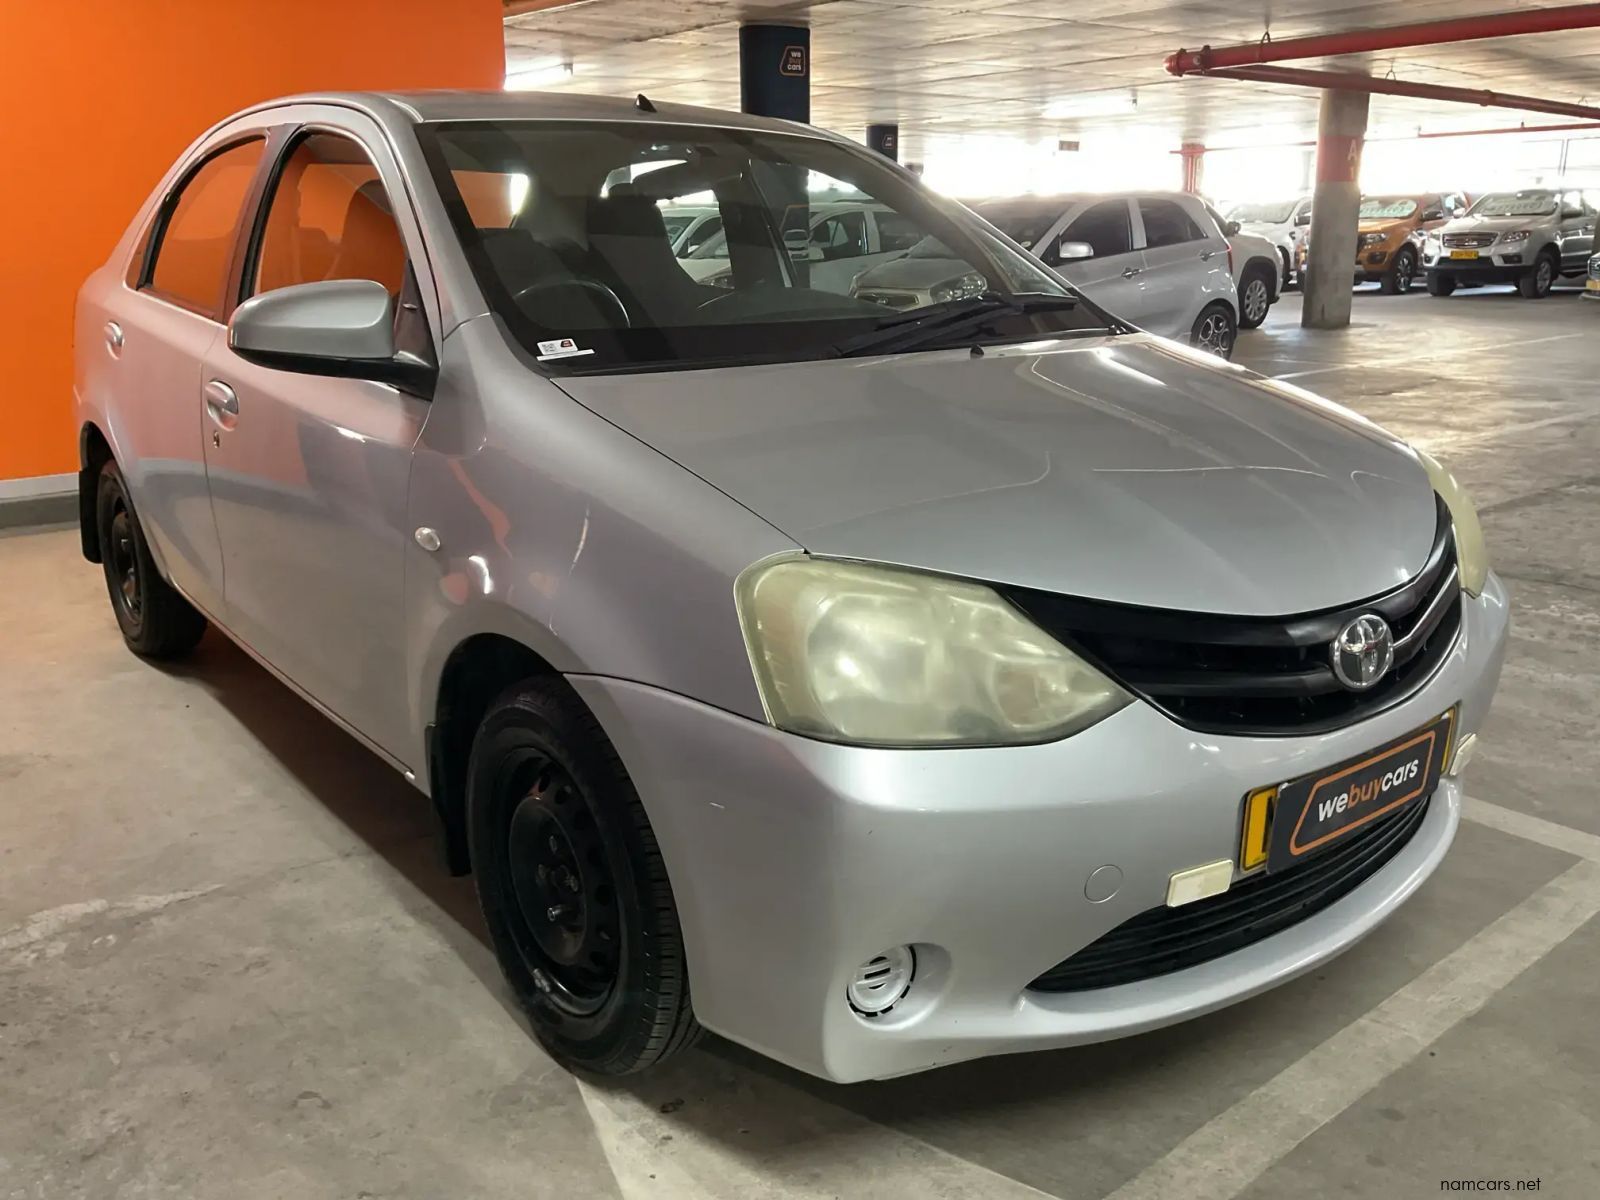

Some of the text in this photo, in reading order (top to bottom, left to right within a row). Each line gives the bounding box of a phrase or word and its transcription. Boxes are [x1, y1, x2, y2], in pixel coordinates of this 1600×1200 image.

[787, 63, 802, 71] cars
[1347, 138, 1358, 161] A
[1318, 759, 1419, 822] webuycars
